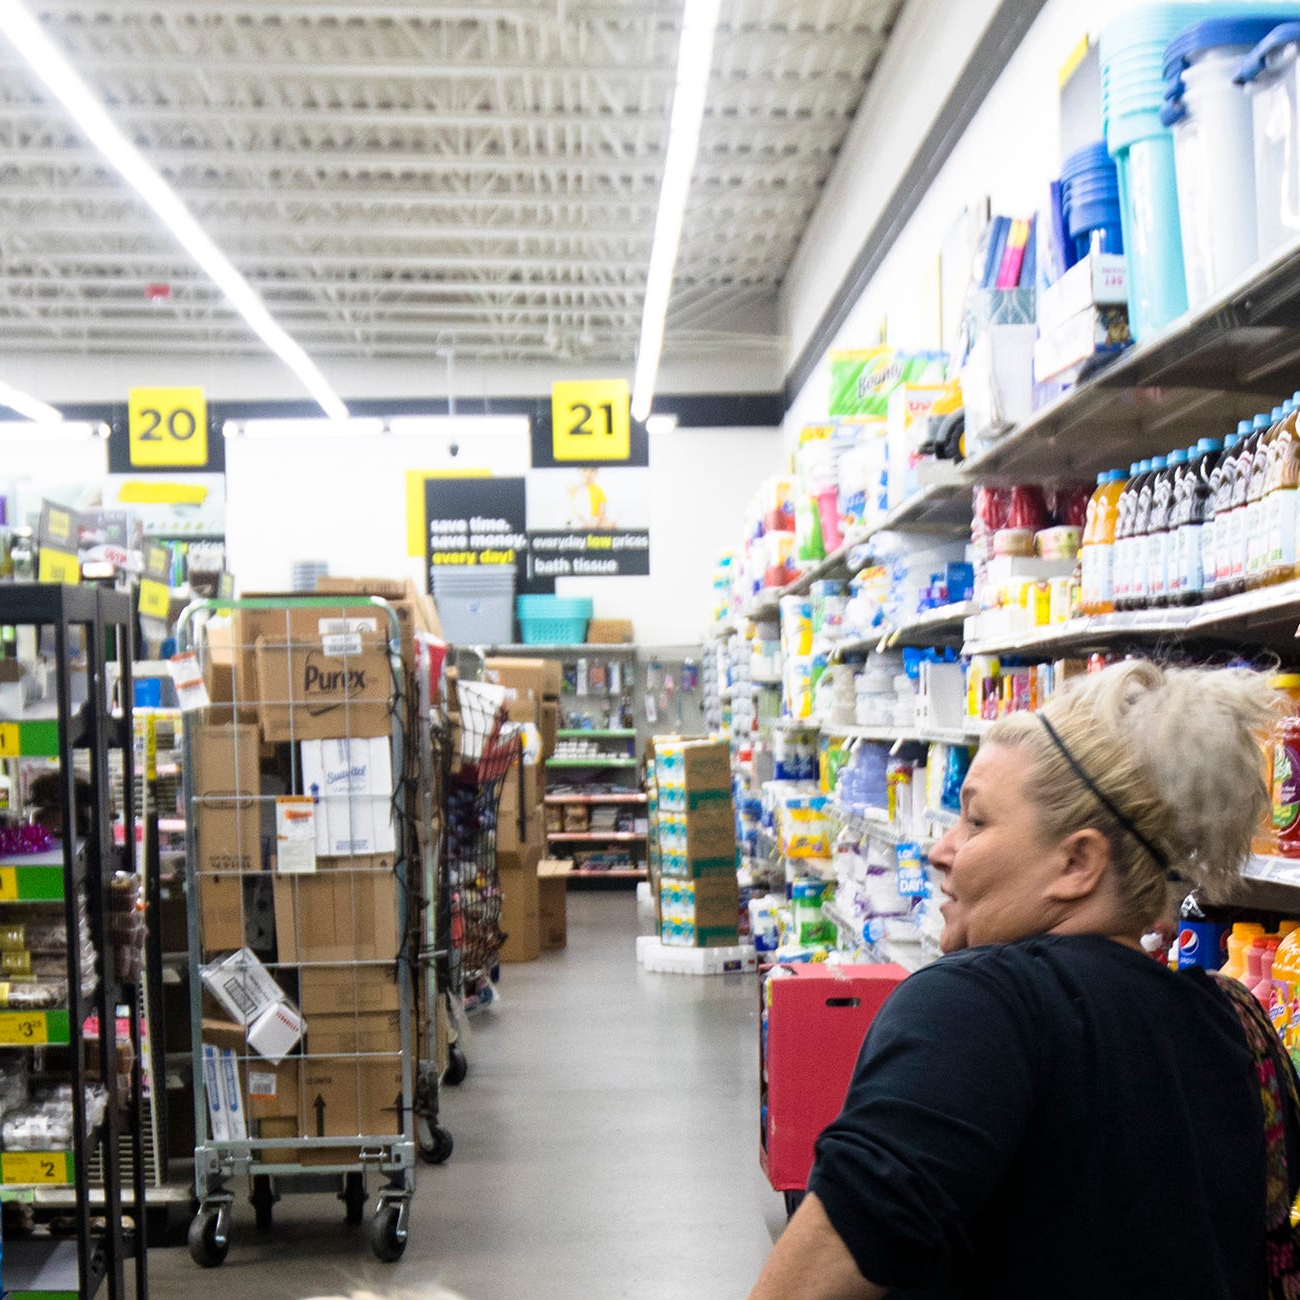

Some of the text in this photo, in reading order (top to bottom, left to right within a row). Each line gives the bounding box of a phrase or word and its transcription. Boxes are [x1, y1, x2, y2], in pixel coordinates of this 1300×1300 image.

[138, 408, 196, 441] 20
[569, 403, 615, 436] 21
[431, 520, 468, 533] save
[431, 535, 468, 548] save
[432, 550, 477, 566] every
[535, 558, 617, 573] bath tissue
[305, 665, 365, 691] Purex
